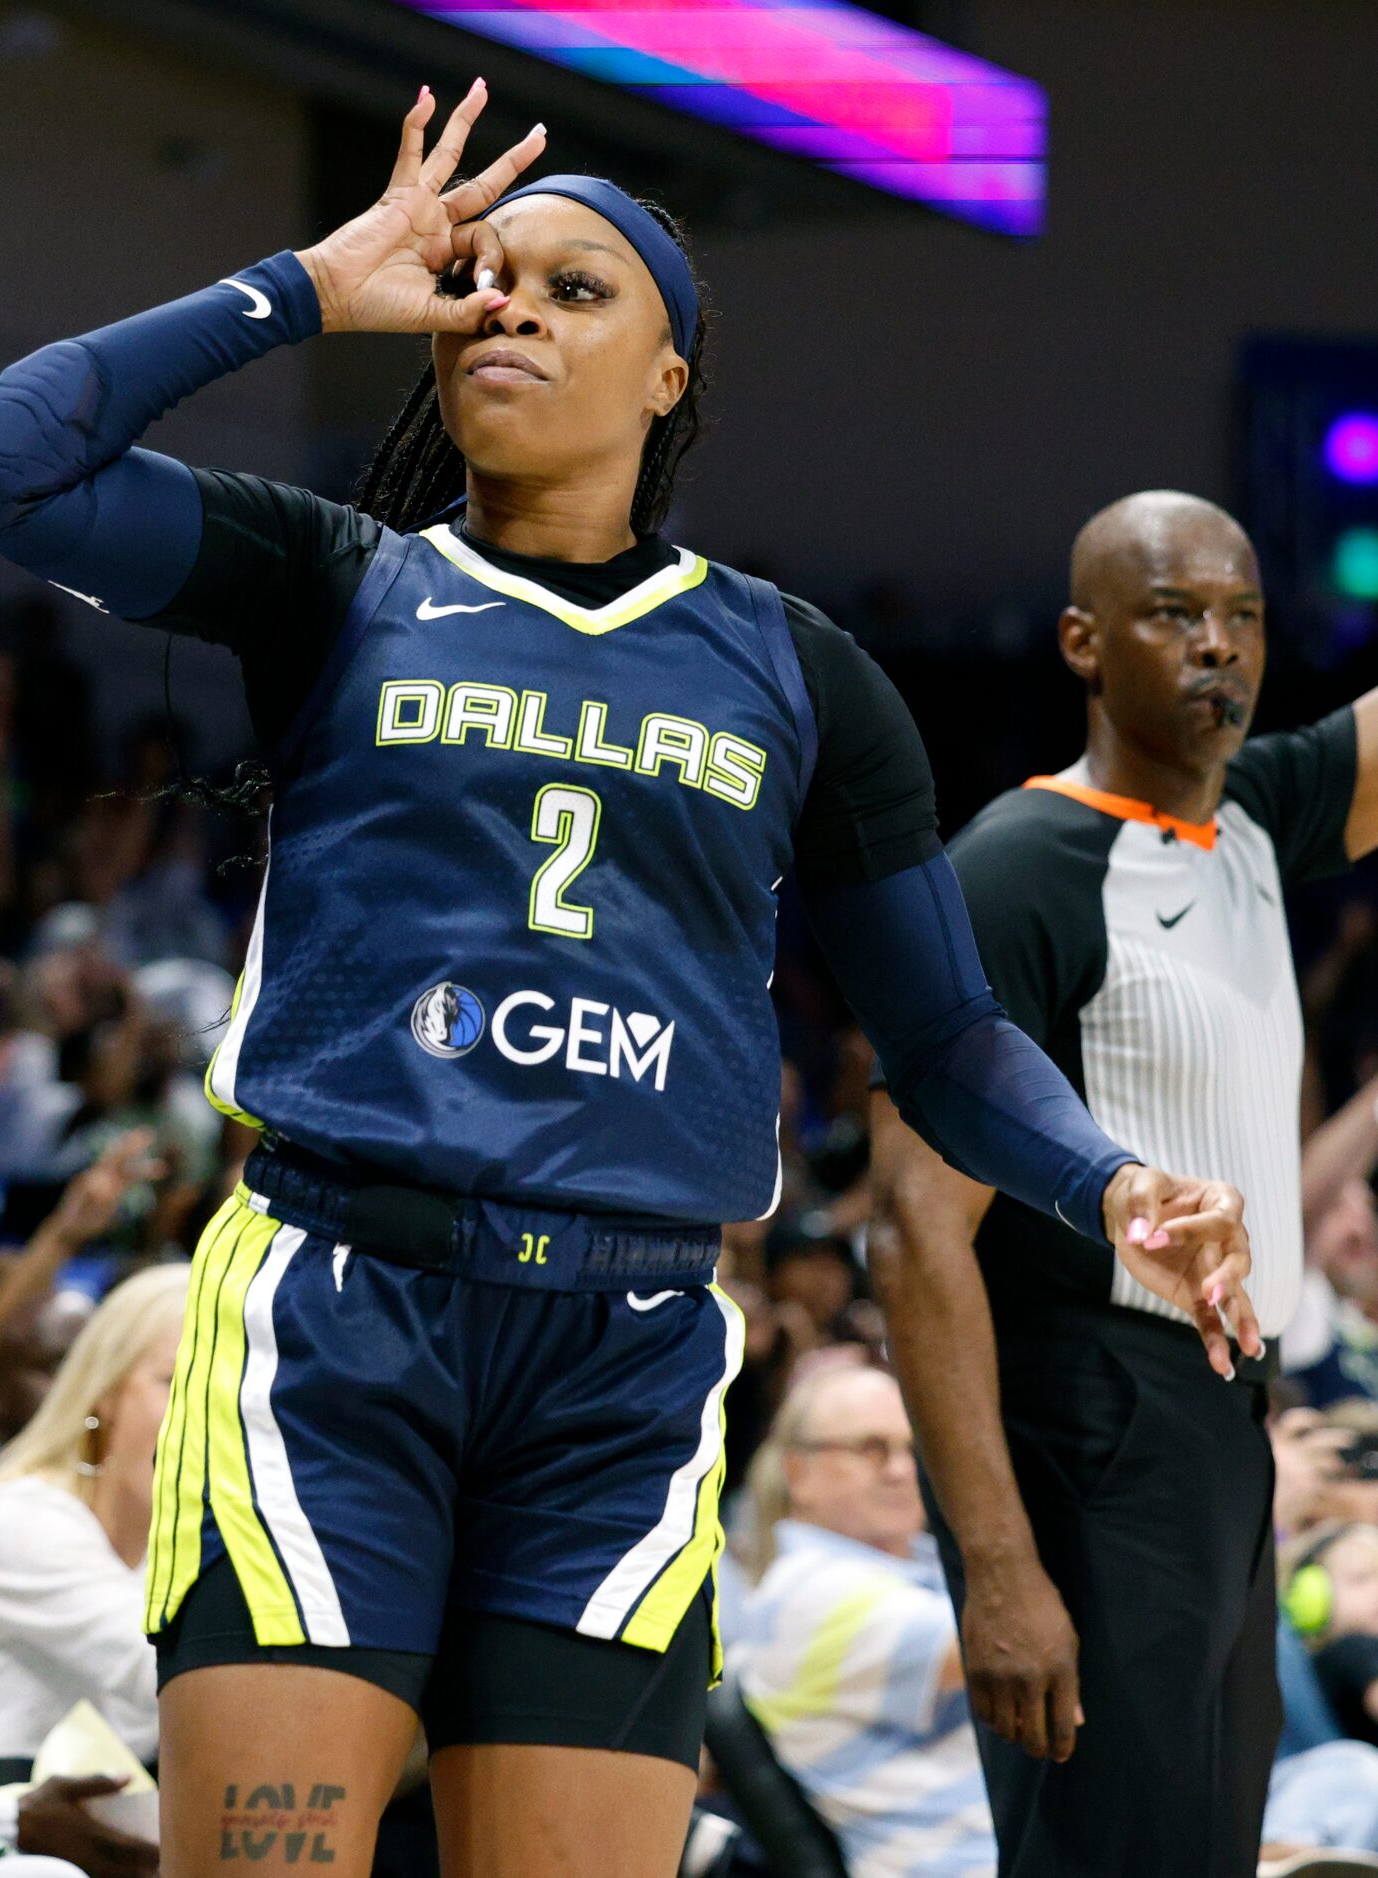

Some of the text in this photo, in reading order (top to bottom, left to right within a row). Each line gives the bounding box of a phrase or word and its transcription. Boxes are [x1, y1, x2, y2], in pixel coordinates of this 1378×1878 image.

[375, 679, 767, 811] DALLAS
[527, 782, 602, 940] 2
[490, 989, 676, 1092] GEM
